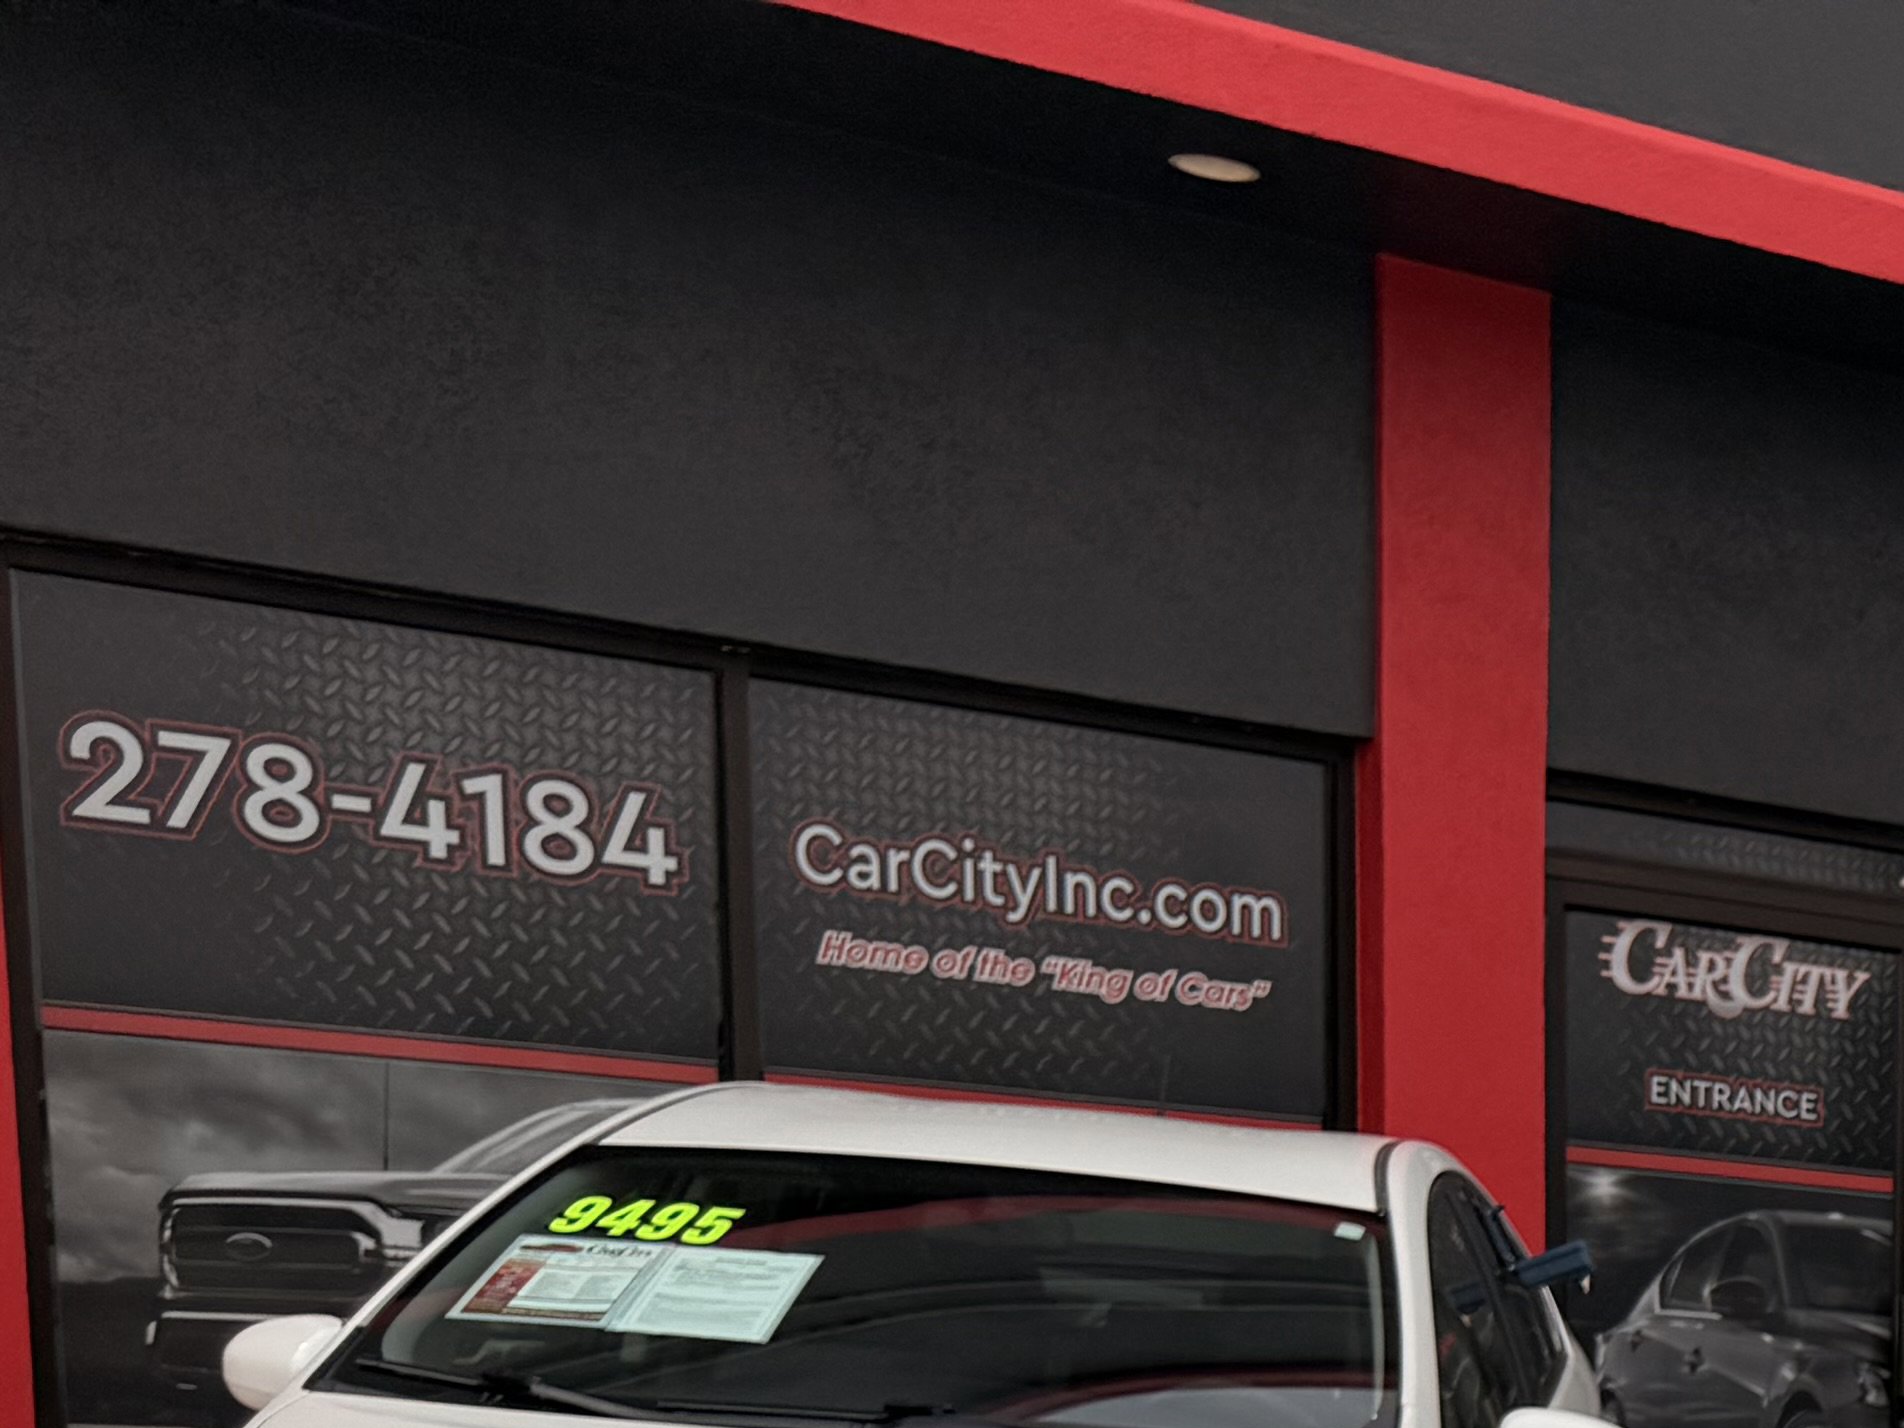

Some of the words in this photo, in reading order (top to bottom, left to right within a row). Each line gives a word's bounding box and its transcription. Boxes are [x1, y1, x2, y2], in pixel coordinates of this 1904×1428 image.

[66, 719, 682, 889] 278-4184
[794, 822, 1284, 942] CarCityInc.com
[816, 930, 928, 976] Home
[930, 945, 974, 979] of
[973, 948, 1035, 987] the
[1132, 970, 1178, 1002] of
[1649, 1074, 1820, 1123] ENTRANCE
[548, 1195, 747, 1245] 9495
